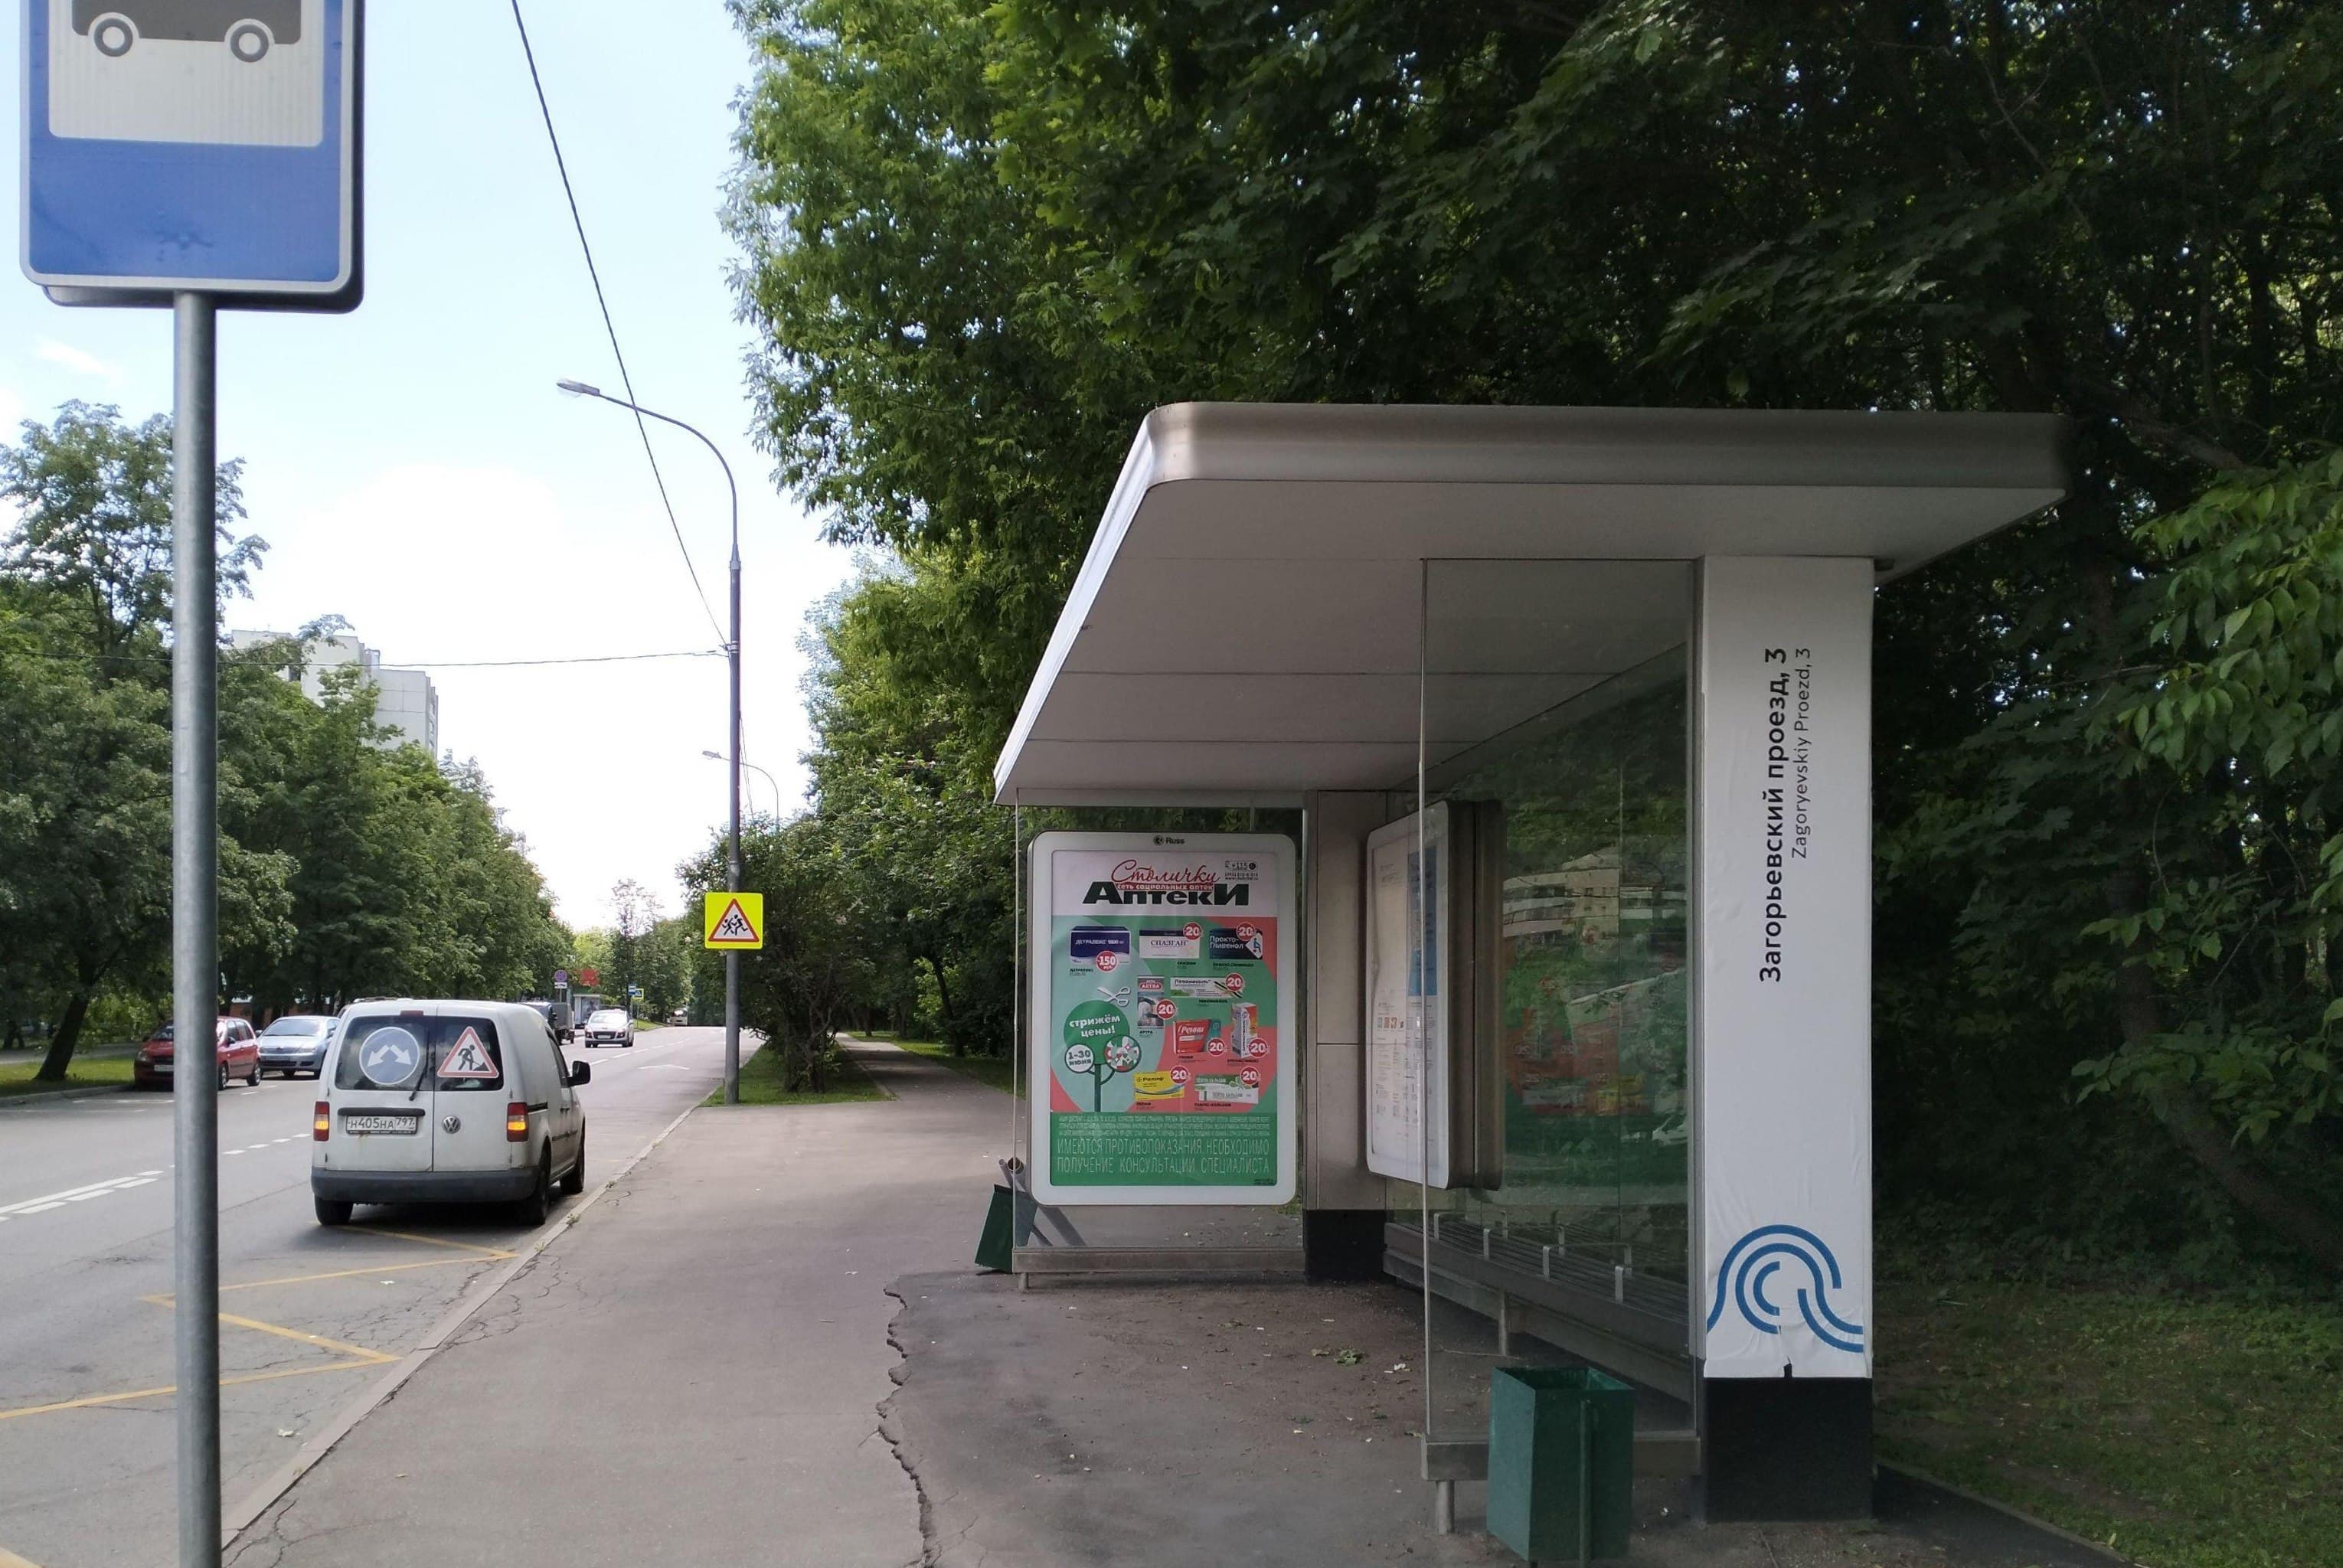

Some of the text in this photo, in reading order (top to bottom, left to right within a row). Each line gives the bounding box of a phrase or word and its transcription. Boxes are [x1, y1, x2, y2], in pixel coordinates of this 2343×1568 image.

[1791, 647, 1813, 859] Zagoryevskiy Proezd, 3
[1760, 648, 1792, 982] Загорьевский проезд, 3
[1111, 859, 1221, 883] Столички
[1210, 935, 1238, 943] Прокто-
[1069, 1014, 1120, 1028] стрижём
[1081, 1025, 1115, 1037] цены!
[1068, 1050, 1091, 1060] 1-30
[396, 1117, 413, 1126] 797
[1057, 1138, 1270, 1155] ИМЕЮТСЯ ПРОТИВОПОКАЗАНИЯ НЕОБХОДИМО
[1057, 1157, 1270, 1174] ПОЛУЧЕНИЕ КОНСУЛЬТАЦИИ СПЕЦИАЛИСТА
